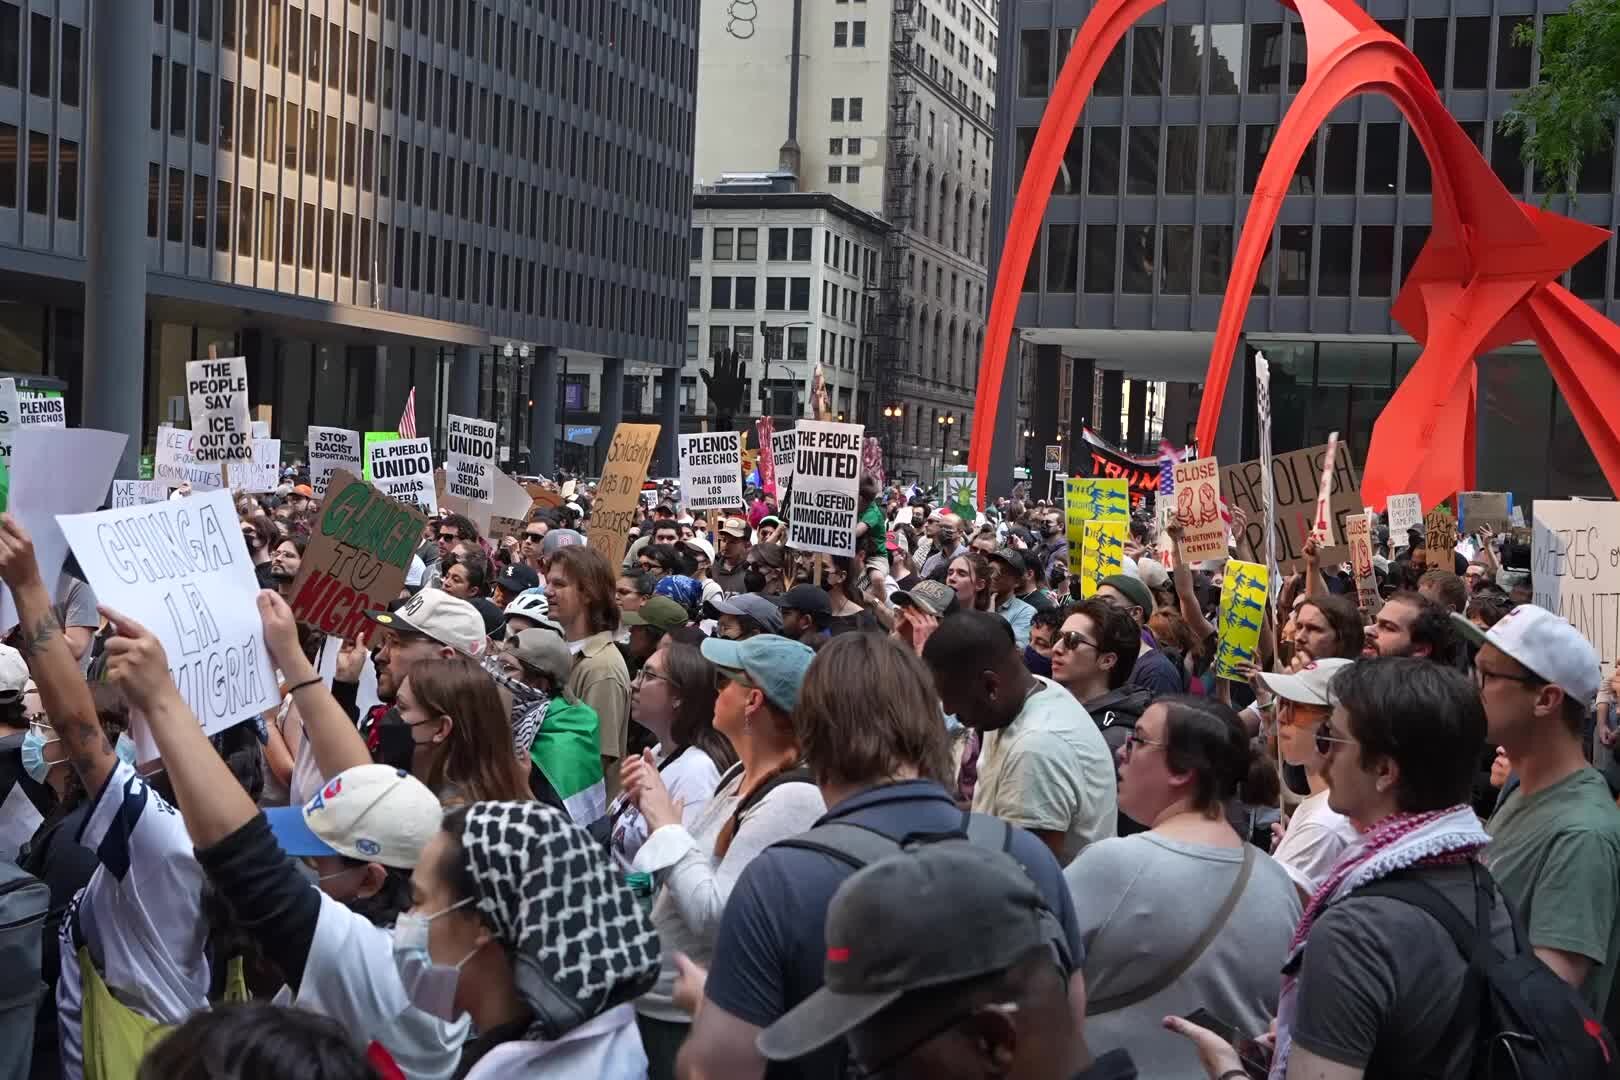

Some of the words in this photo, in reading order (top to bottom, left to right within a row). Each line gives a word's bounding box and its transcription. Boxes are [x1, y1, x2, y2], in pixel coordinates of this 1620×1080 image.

[202, 363, 231, 377] THE
[190, 378, 245, 394] PEOPLE
[20, 400, 62, 414] PLENOS
[205, 395, 232, 410] SAY
[21, 413, 64, 424] DERECHOS
[208, 417, 235, 432] ICE
[320, 432, 347, 443] STOP
[450, 421, 461, 433] ¡EL
[463, 423, 494, 439] PUEBLO
[200, 434, 225, 447] OUT
[229, 433, 247, 445] OF
[449, 434, 493, 459] UNIDO
[689, 436, 738, 454] PLENOS
[772, 433, 795, 453] PLEN
[797, 431, 817, 448] THE
[818, 433, 860, 451] PEOPLE
[196, 446, 252, 461] CHICAGO
[315, 442, 353, 455] RACIST
[371, 448, 387, 461] ¡EL
[389, 443, 428, 457] PUEBLO
[311, 452, 360, 463] DEPORTATION
[689, 452, 739, 466] DERECHOS
[796, 449, 858, 480] UNITED
[158, 463, 221, 487] COMMUNITIES
[372, 456, 431, 479] UNIDO
[456, 461, 485, 477] JAMÁS
[1091, 452, 1162, 491] TRUM
[1176, 462, 1216, 483] CLOSE
[387, 480, 424, 495] JAMÁS
[458, 473, 479, 487] SERÁ
[692, 476, 712, 486] PARA
[713, 474, 737, 485] TODOS
[115, 482, 135, 496] WE
[450, 482, 488, 500] VENCIDO!
[707, 486, 722, 495] LOS
[690, 495, 740, 507] INMIGRANTES
[793, 490, 814, 507] WILL
[816, 493, 855, 512] DEFEND
[793, 507, 853, 529] IMMIGRANT
[97, 504, 233, 585] CHINGA
[791, 525, 852, 550] FAMILIES!
[1186, 542, 1221, 553] CENTERS
[328, 542, 383, 592] TU
[164, 583, 221, 656] LA
